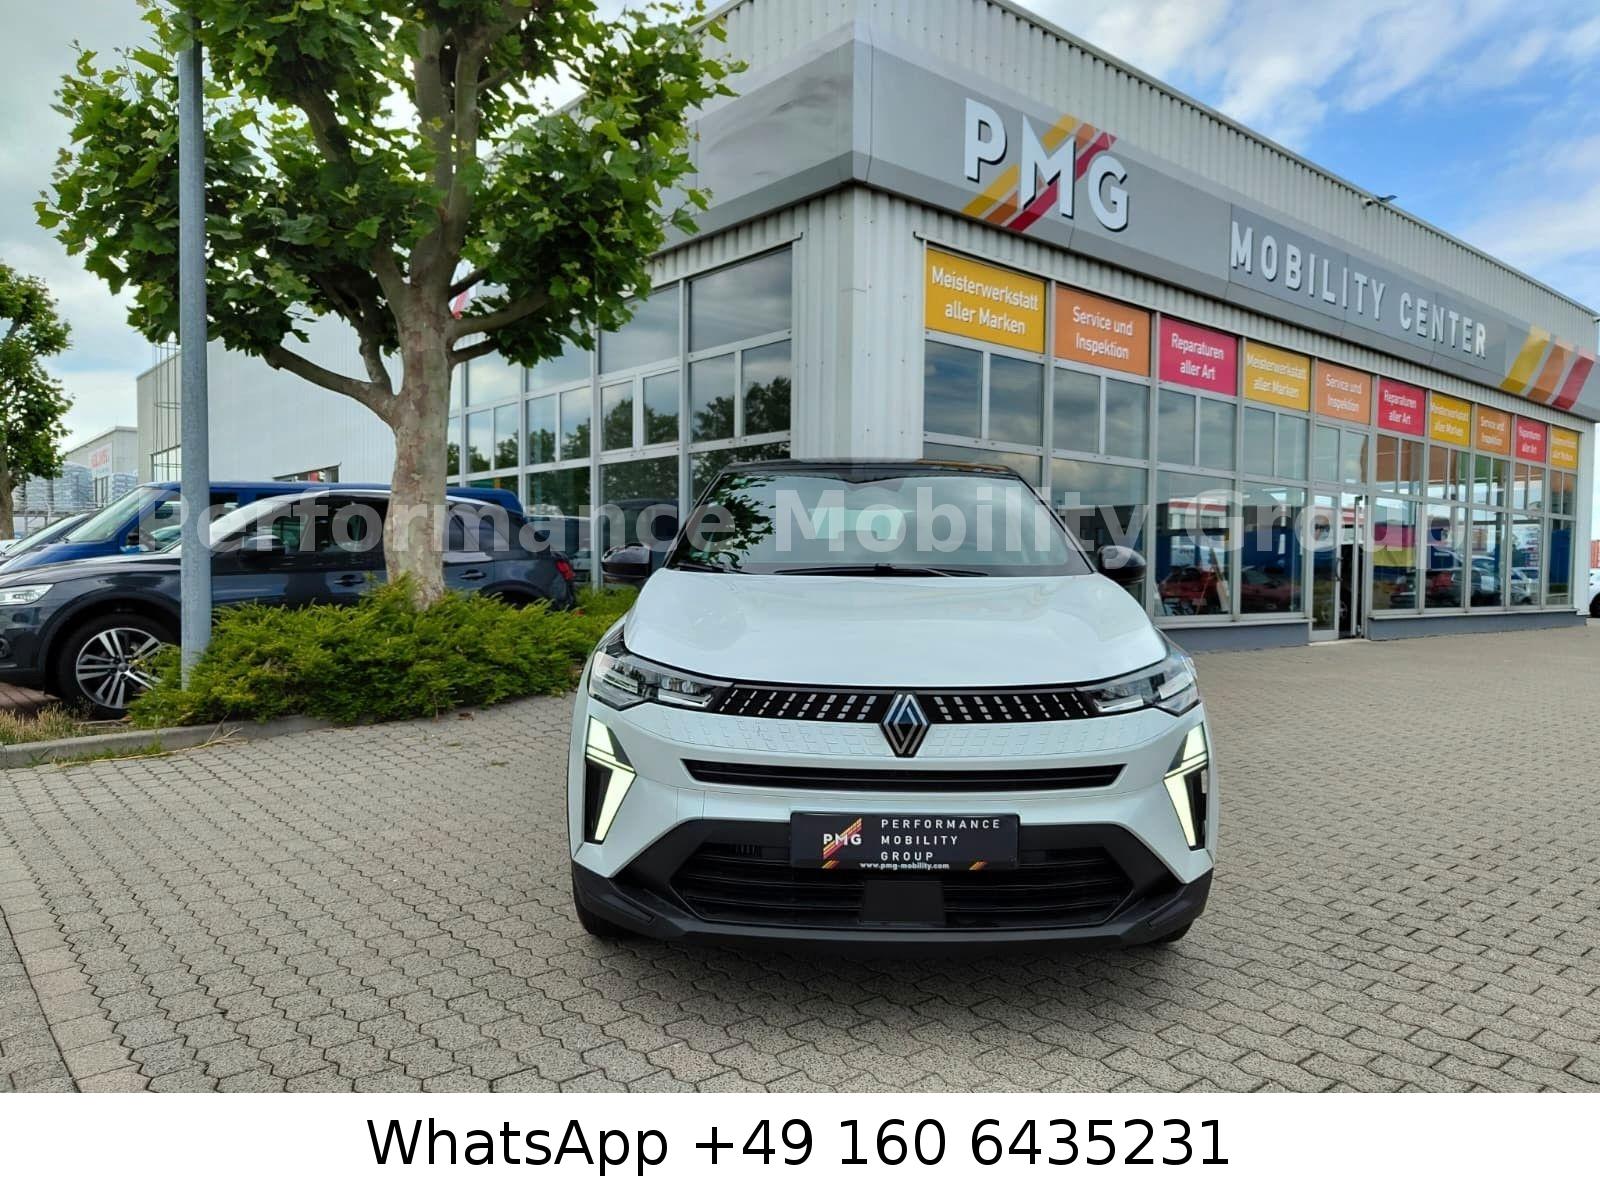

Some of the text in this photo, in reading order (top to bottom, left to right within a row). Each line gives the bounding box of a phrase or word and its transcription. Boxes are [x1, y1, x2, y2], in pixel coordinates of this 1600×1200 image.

[964, 97, 1129, 231] PMG
[931, 265, 1040, 311] Meisterwerkstatt
[1230, 220, 1487, 360] MOBILITY CENTER
[945, 301, 1026, 335] aller Marken
[1072, 306, 1133, 336] Service und
[1076, 332, 1129, 360] Inspektion
[1171, 332, 1224, 361] Reparaturen
[1180, 361, 1216, 381] aller Art
[881, 818, 1001, 829] PERFORMANCE
[823, 833, 862, 846] PMG
[881, 835, 959, 846] MOBILITY
[859, 861, 950, 871] www.pmg-mobility.com
[881, 851, 934, 862] GROUP
